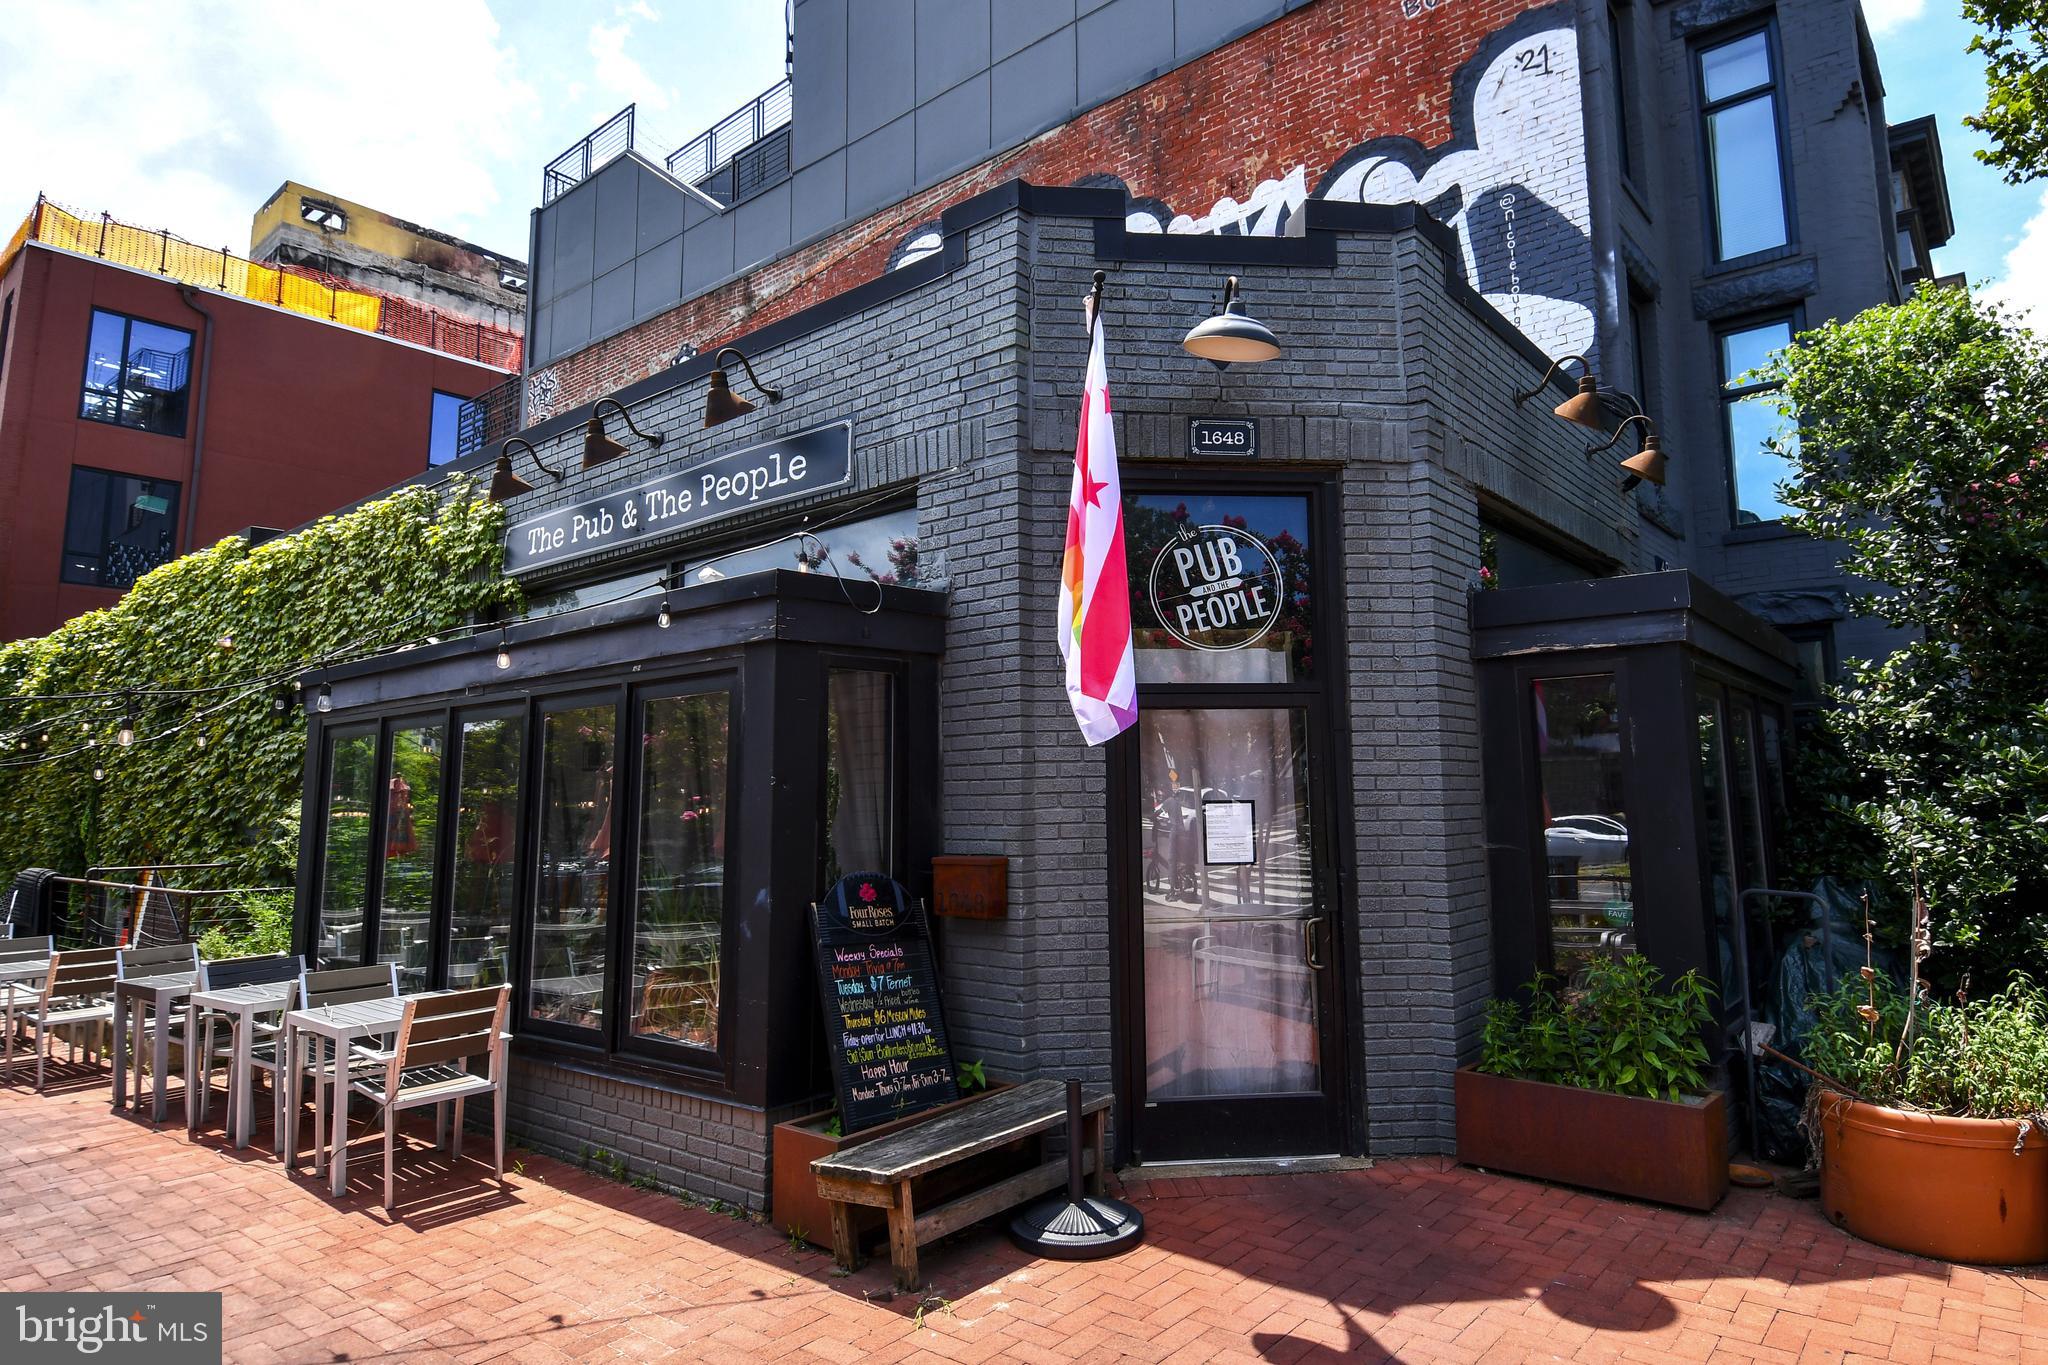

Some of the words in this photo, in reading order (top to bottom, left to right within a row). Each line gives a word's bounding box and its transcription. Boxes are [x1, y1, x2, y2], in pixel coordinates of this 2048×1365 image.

[1201, 431, 1244, 445] 1648
[528, 526, 564, 556] The
[570, 508, 614, 544] Pub
[621, 500, 638, 529] &
[645, 488, 692, 522] The
[700, 453, 807, 506] People
[1176, 523, 1198, 542] the
[1173, 537, 1243, 588] PUB
[1202, 583, 1216, 594] AND
[1216, 580, 1230, 592] THE
[1176, 585, 1271, 637] PEOPLE
[852, 920, 873, 928] SMALL
[875, 919, 895, 927] BATCH
[834, 947, 865, 962] Weekly
[869, 943, 903, 959] Specials
[886, 974, 913, 990] Fernet
[885, 1024, 907, 1040] LUNCH
[860, 1064, 887, 1081] Happy
[888, 1059, 909, 1075] Hour
